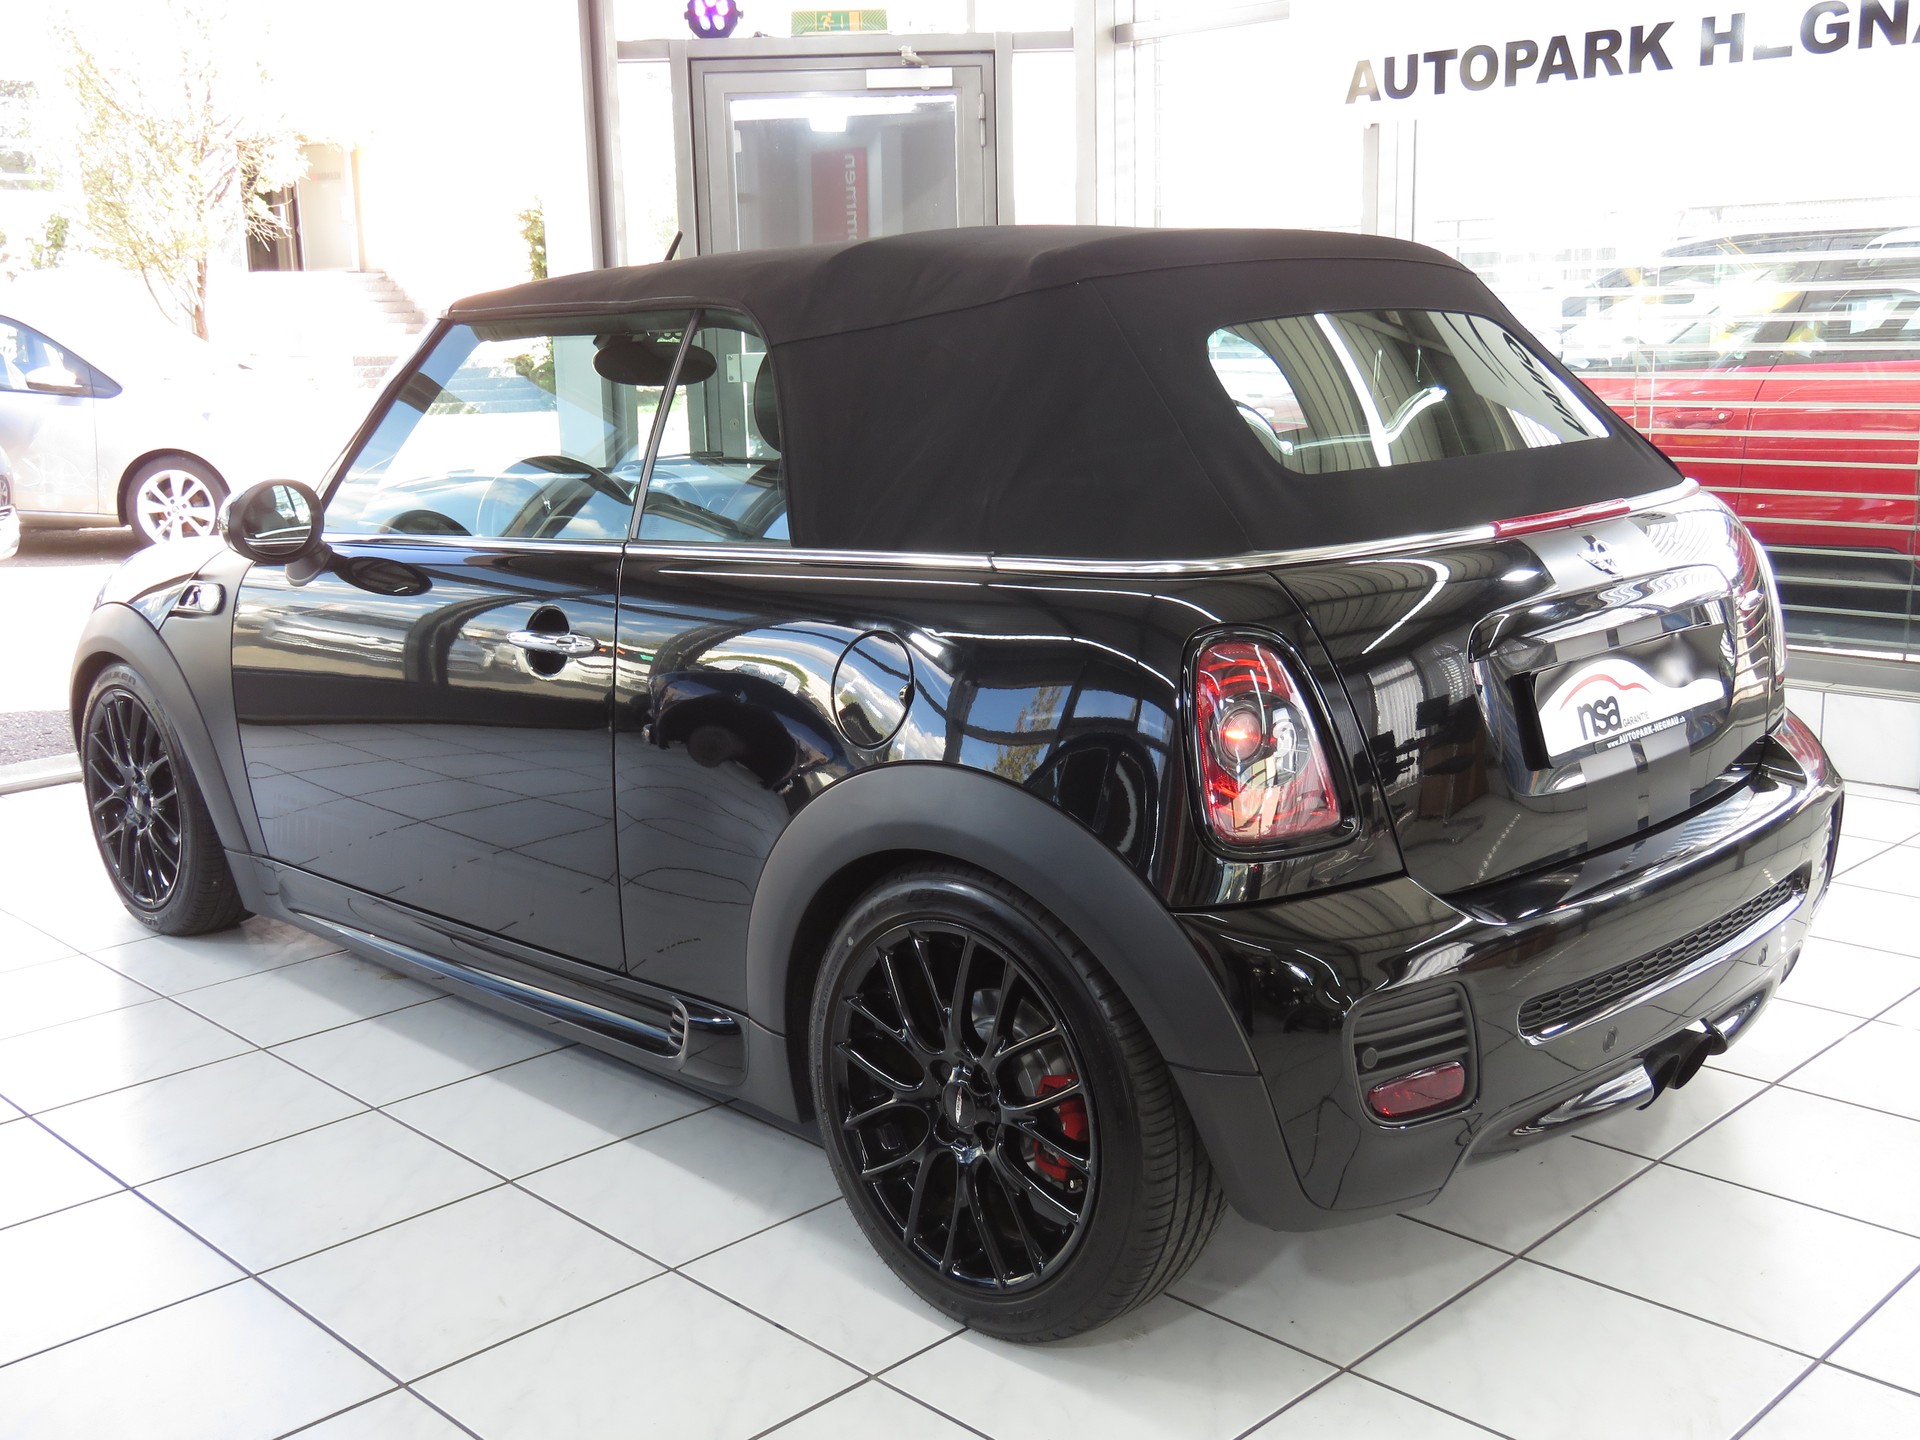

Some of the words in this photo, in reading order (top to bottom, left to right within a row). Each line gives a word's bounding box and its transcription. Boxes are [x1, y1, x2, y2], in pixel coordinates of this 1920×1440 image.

[1345, 21, 1675, 104] AUTOPARK
[1700, 0, 1920, 66] HGN
[1577, 696, 1622, 740] nsa
[1622, 711, 1650, 728] GARANTIE
